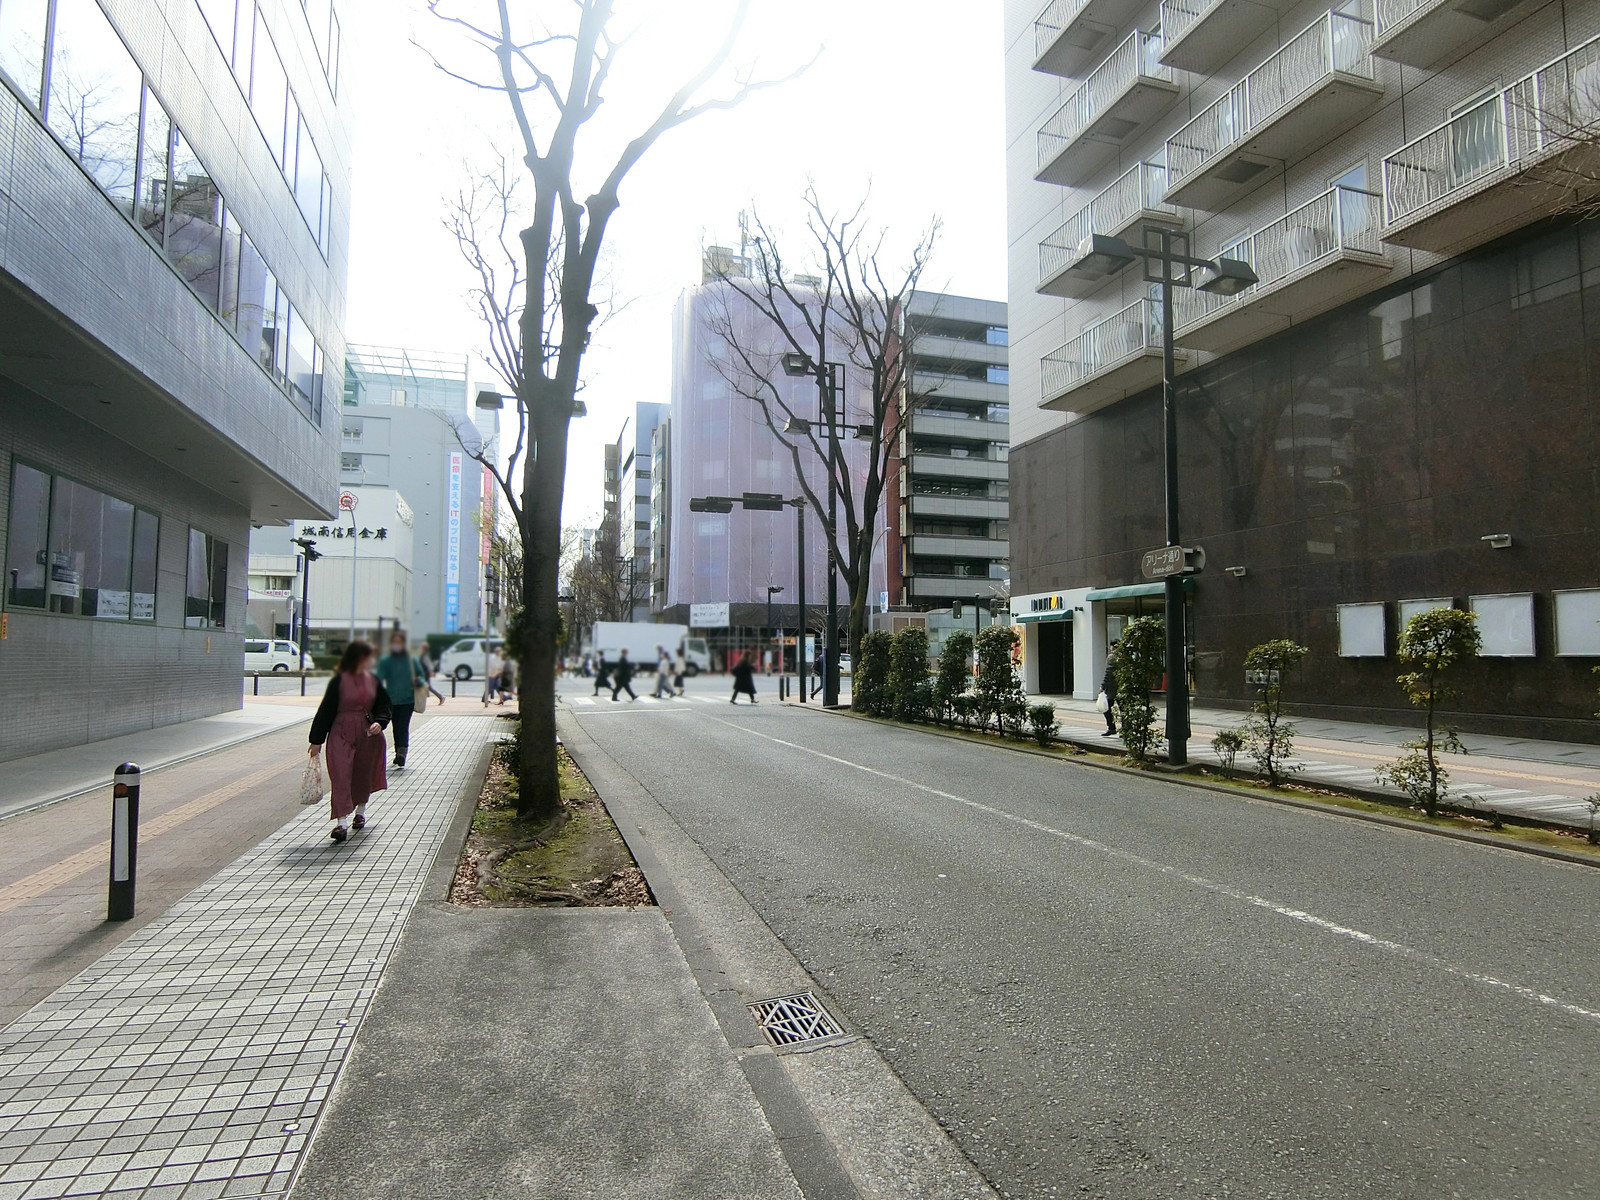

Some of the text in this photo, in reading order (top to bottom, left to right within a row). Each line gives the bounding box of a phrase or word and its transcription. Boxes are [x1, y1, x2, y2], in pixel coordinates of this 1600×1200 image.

[302, 526, 388, 541] 城南信用金庫
[1145, 549, 1181, 567] アリーナ通り
